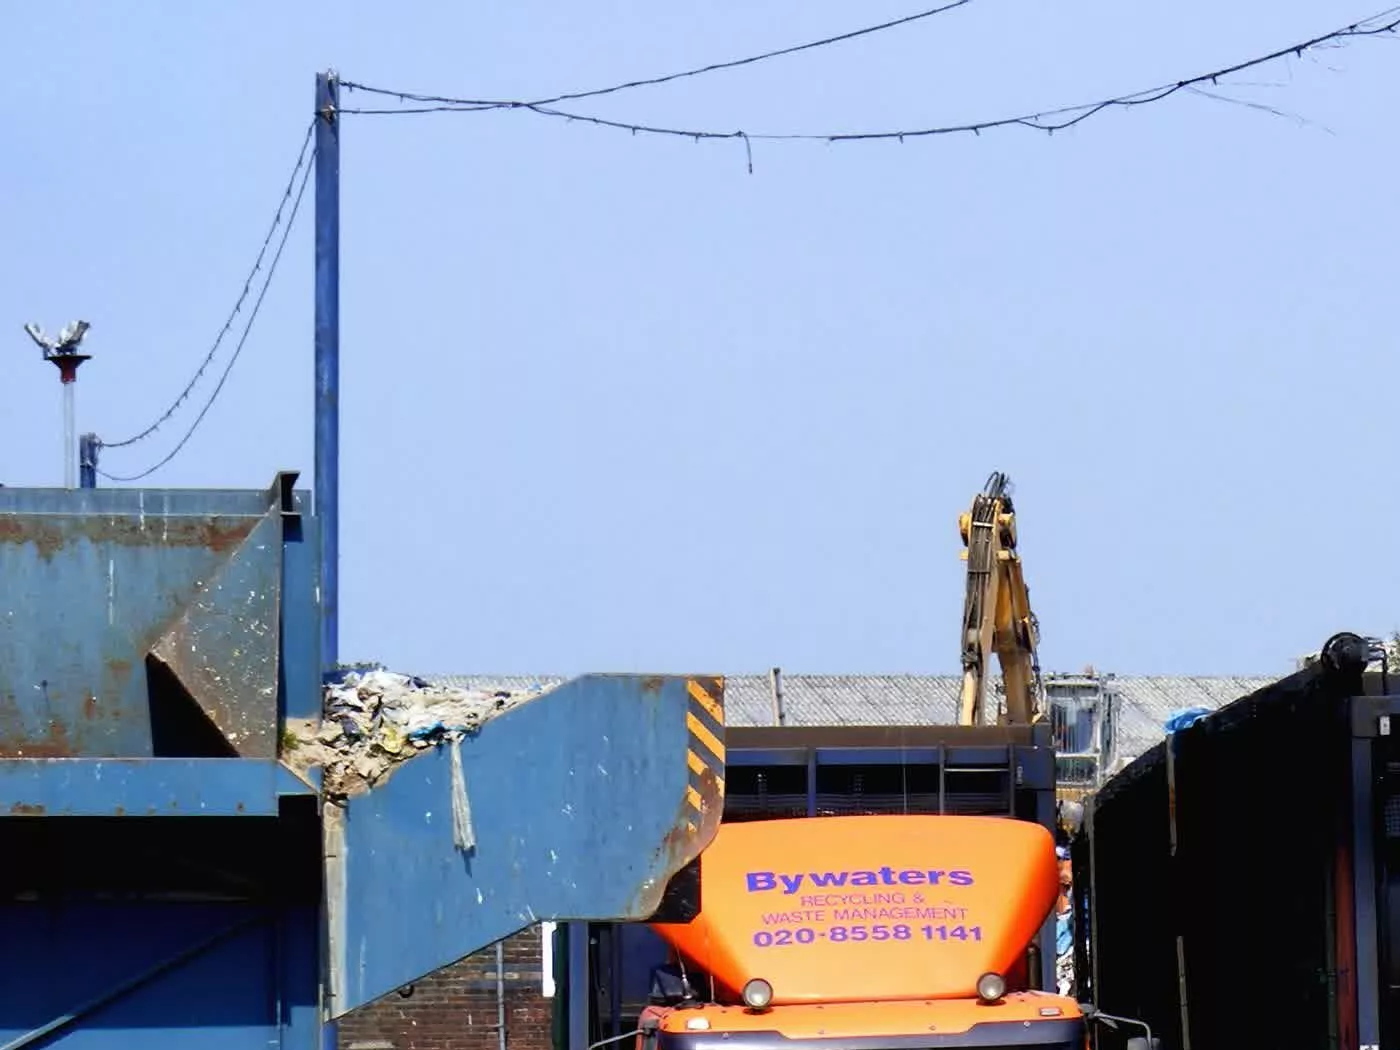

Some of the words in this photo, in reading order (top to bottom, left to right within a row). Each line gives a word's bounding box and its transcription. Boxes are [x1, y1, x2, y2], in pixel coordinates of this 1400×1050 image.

[746, 866, 975, 895] Bywaters
[800, 892, 905, 908] RECYCLING
[912, 892, 925, 904] &
[761, 909, 826, 926] WASTE
[833, 906, 969, 921] MANAGEMENT
[921, 925, 982, 942] 1141
